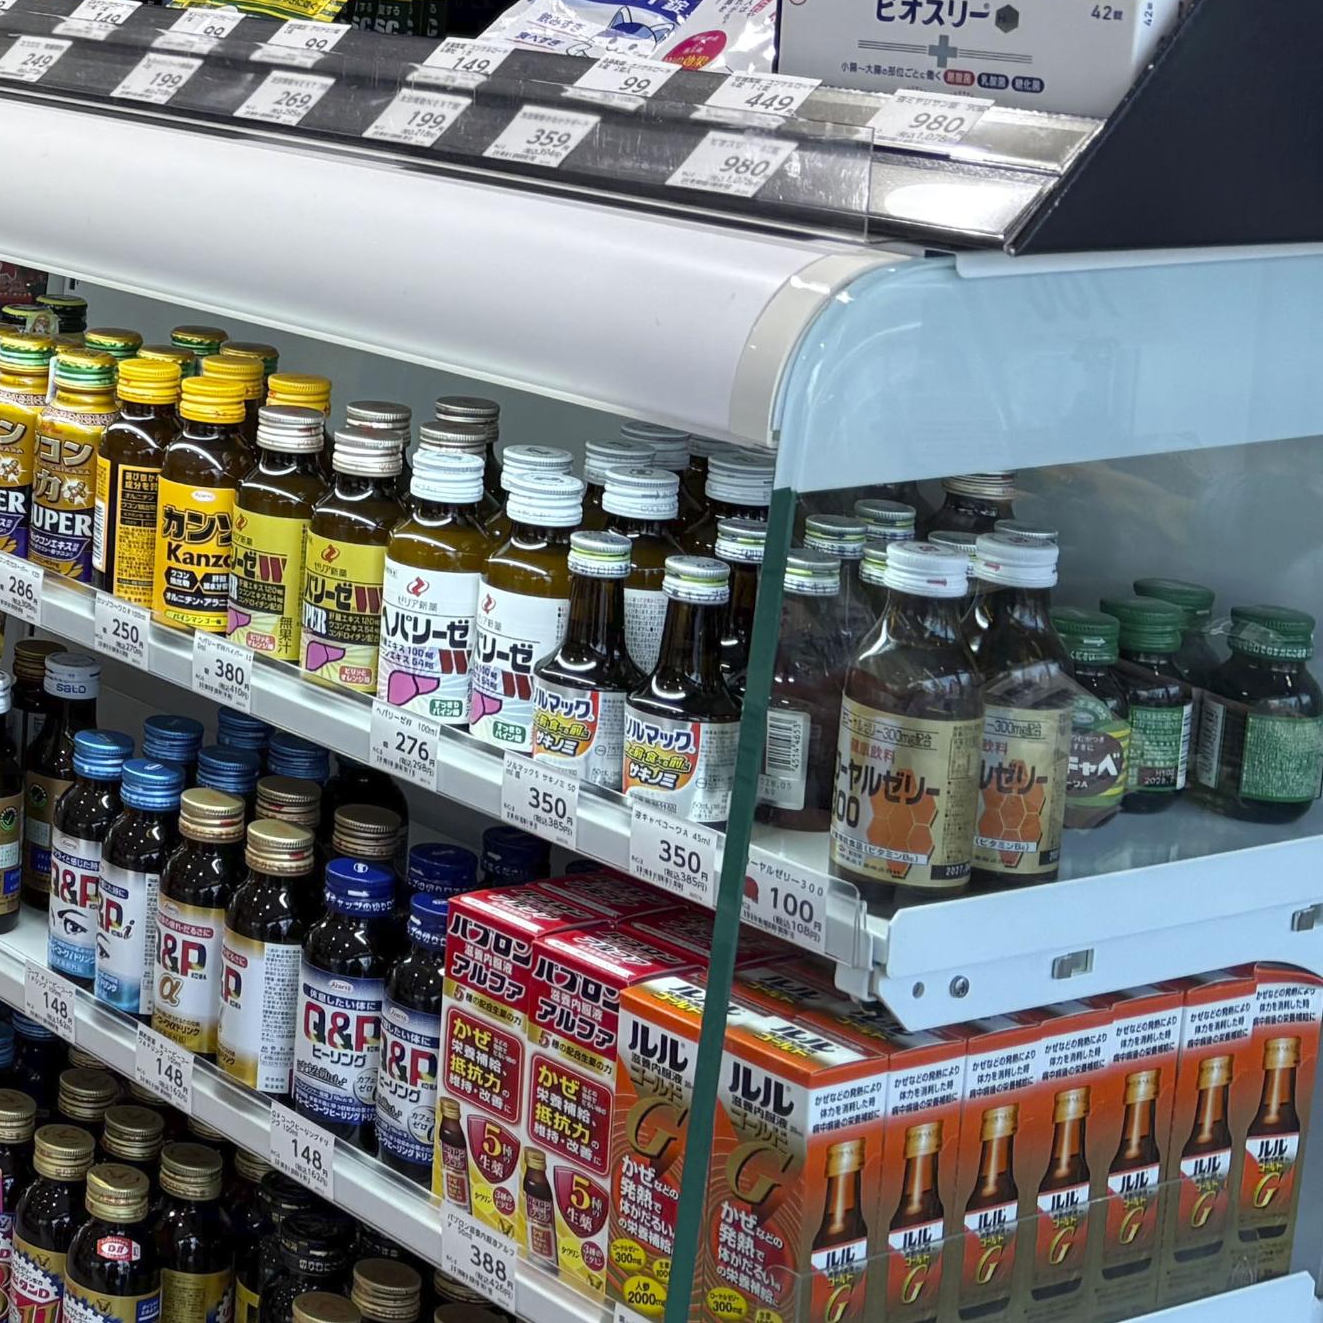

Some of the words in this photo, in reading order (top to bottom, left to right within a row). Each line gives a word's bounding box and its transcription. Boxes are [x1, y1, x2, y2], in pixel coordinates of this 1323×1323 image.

[1090, 4, 1123, 22] 42錠
[277, 617, 292, 654] 無果汁
[535, 732, 579, 756] サキノミ
[629, 762, 679, 790] サキノミ
[658, 839, 709, 881] 350円
[769, 887, 822, 931] 100円
[450, 914, 533, 969] パブロン
[464, 943, 513, 976] 滋養内服液
[451, 954, 525, 1000] アルファ
[533, 957, 619, 1013] パブロン
[551, 989, 603, 1021] 滋養内服液
[1189, 1002, 1251, 1025] かぜなどの発熱により
[536, 1005, 616, 1050] アルファ
[628, 1019, 689, 1072] ルル
[313, 1045, 366, 1068] ヒーリング
[450, 1041, 509, 1077] 栄養補給、
[630, 1052, 682, 1086] 滋養内服液
[449, 1057, 510, 1098] 抵抗力の
[729, 1060, 795, 1117] ルル
[814, 1081, 883, 1107] かぜなどの発熱により
[894, 1064, 960, 1090] かぜなどの発熱により
[448, 1076, 512, 1115] 維持・改善に
[536, 1089, 596, 1127] 栄養補給、
[731, 1095, 789, 1131] 滋養内服液
[534, 1102, 600, 1149] 抵抗力の
[533, 1121, 602, 1167] 維持・改善に
[1259, 1139, 1288, 1158] ルル
[566, 1208, 593, 1233] 生薬
[719, 1228, 765, 1263] 発熱で
[825, 1245, 854, 1270] ルル
